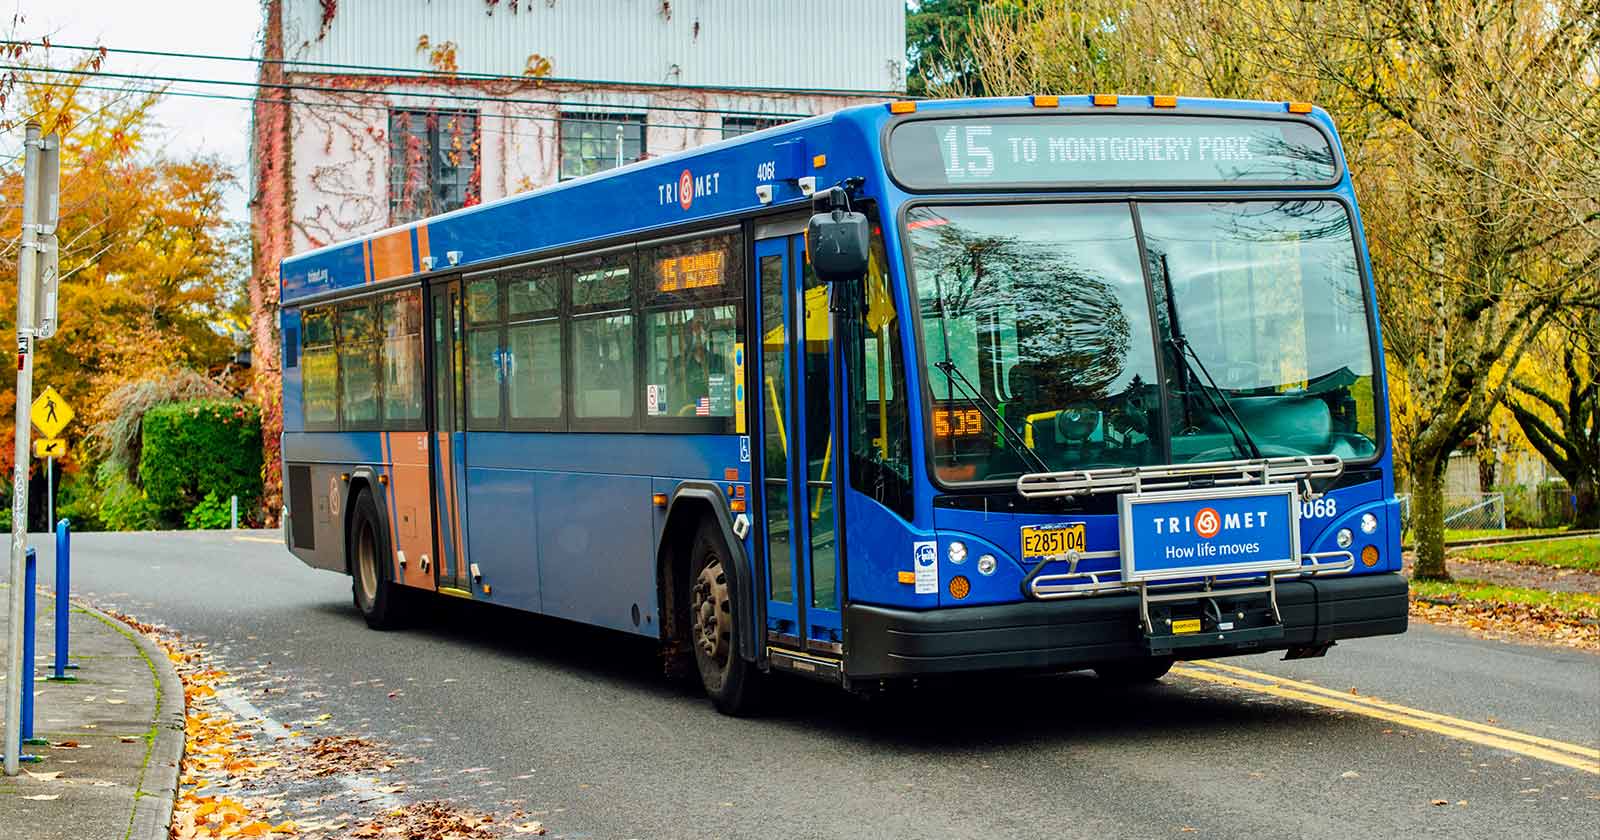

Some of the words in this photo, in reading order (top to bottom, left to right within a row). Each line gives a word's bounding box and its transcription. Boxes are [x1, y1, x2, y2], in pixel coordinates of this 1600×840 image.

[943, 125, 995, 177] 15
[1007, 136, 1037, 162] TO
[1048, 136, 1193, 161] MONTGOMERY
[1198, 136, 1253, 160] PARK
[658, 182, 678, 205] TRI
[695, 172, 720, 198] MET
[1298, 498, 1336, 519] 068
[1153, 516, 1191, 534] TRI
[1224, 511, 1268, 529] MET
[1025, 531, 1083, 552] E285104
[1165, 544, 1194, 559] How
[1197, 542, 1217, 557] life
[1219, 541, 1259, 556] moves
